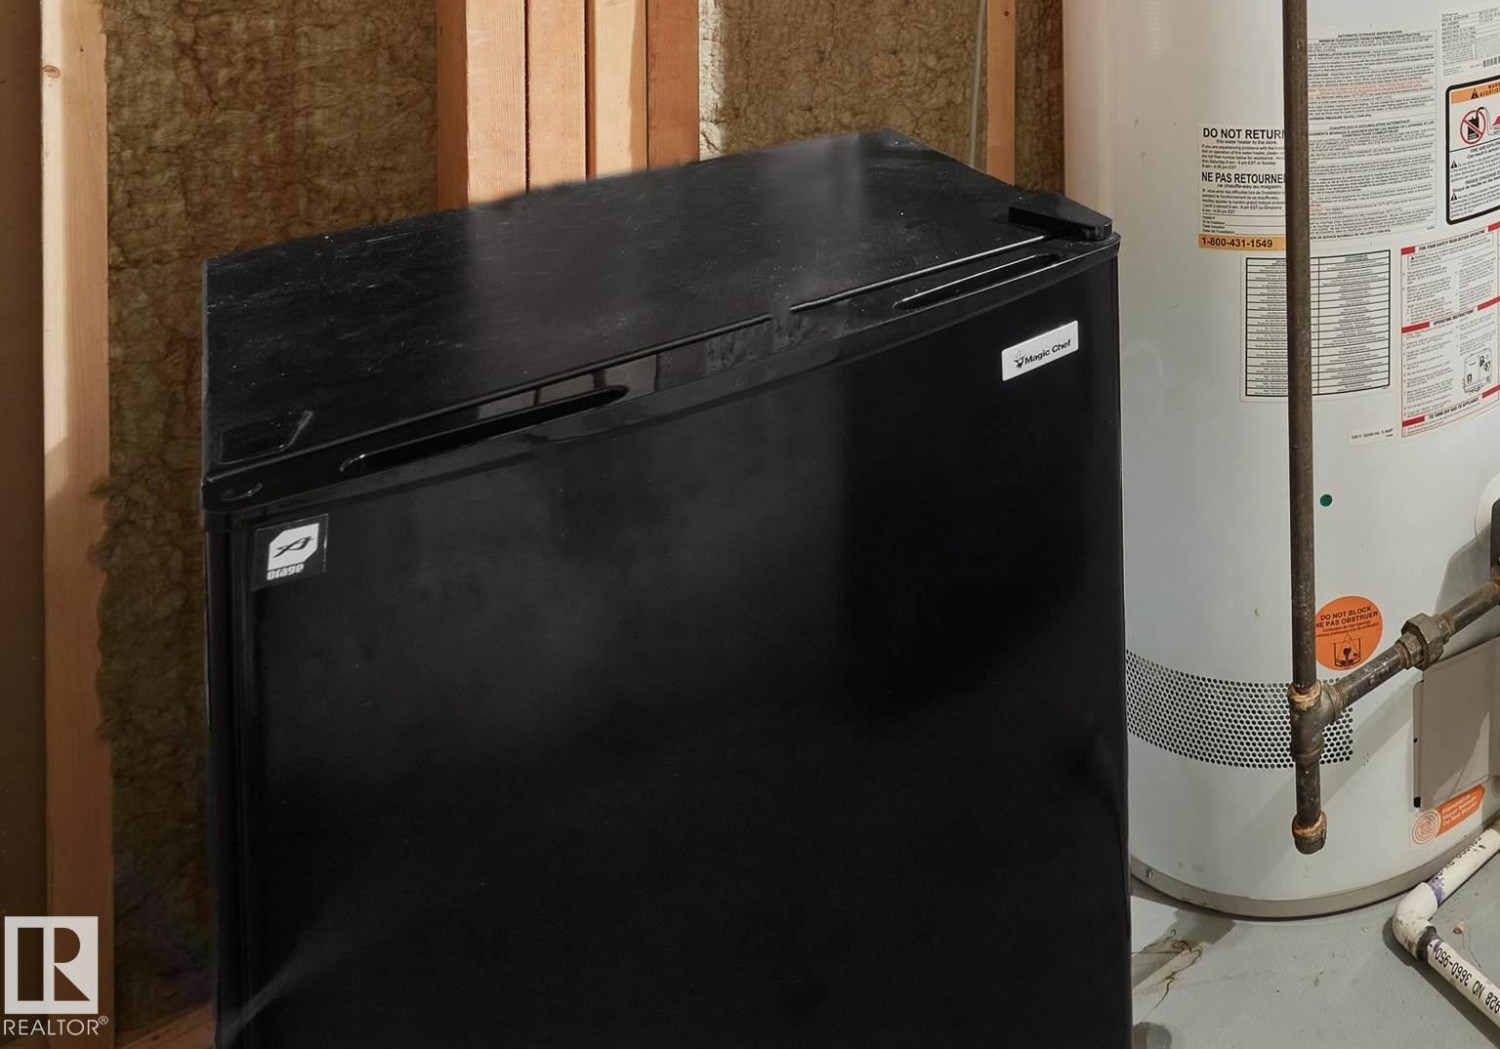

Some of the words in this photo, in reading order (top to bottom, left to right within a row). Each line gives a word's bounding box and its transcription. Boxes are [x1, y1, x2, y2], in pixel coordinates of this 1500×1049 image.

[1203, 127, 1218, 138] DO
[1220, 128, 1243, 139] NOT
[1201, 172, 1214, 182] NE
[1215, 173, 1232, 183] PAS
[1234, 173, 1286, 184] RETOURNE
[1201, 236, 1273, 248] 1-800-431-1549
[1024, 349, 1051, 365] Magic
[1051, 338, 1071, 354] Chef
[1332, 611, 1346, 619] NOT
[1348, 606, 1372, 616] BLOCK
[1341, 610, 1378, 624] OBSTRUER
[1435, 948, 1472, 987] 3660-950
